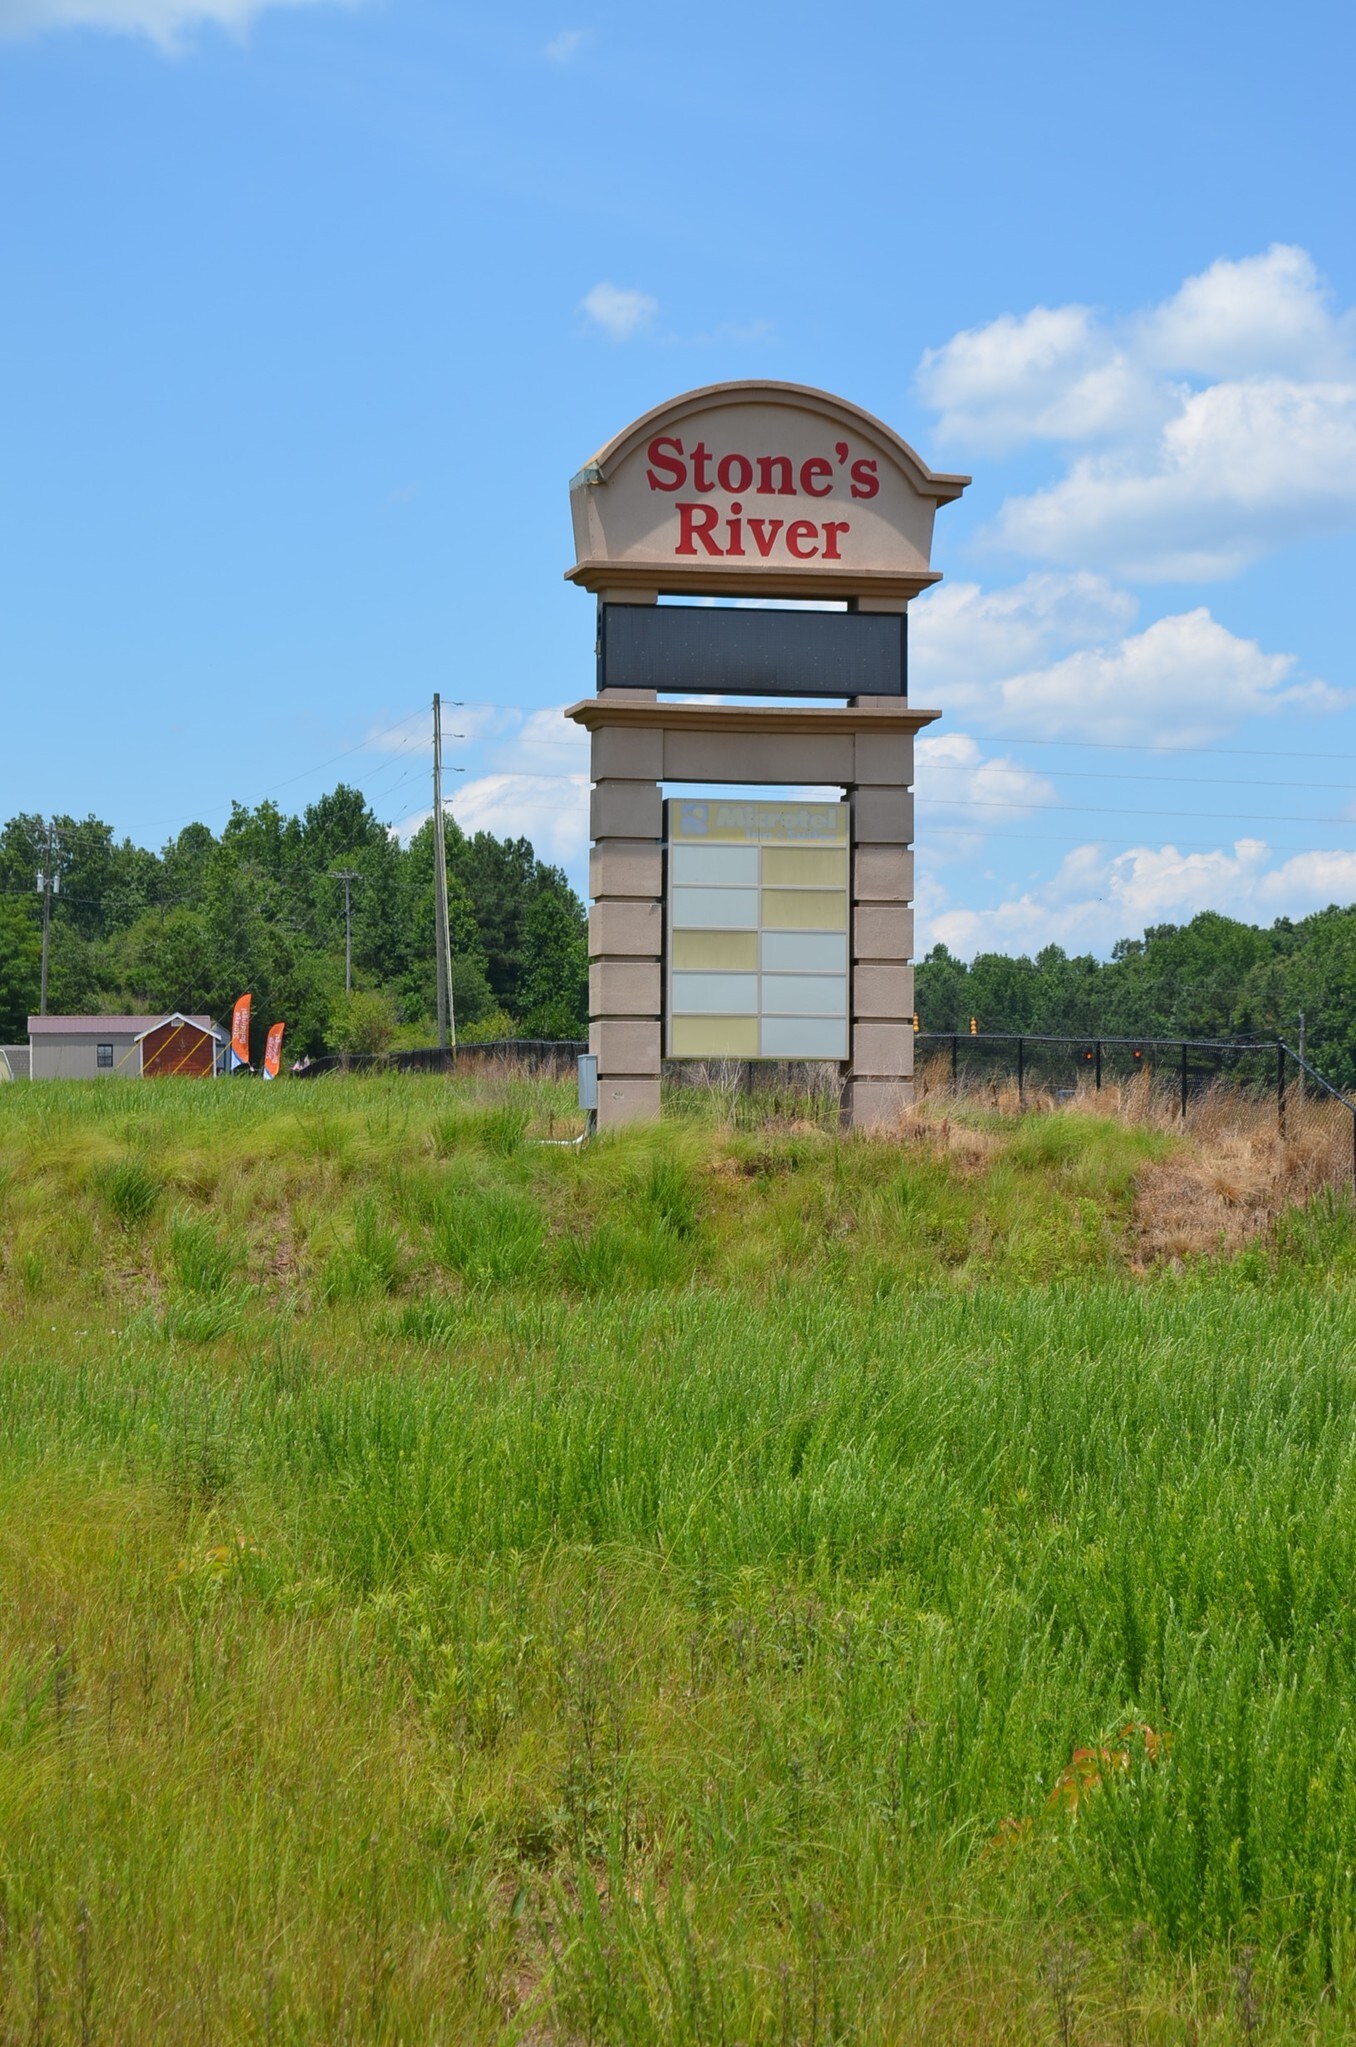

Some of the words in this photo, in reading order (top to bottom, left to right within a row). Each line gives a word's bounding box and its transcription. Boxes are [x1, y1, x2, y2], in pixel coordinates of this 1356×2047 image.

[646, 437, 880, 499] Stone's
[675, 502, 850, 559] River
[716, 806, 837, 828] Microtel
